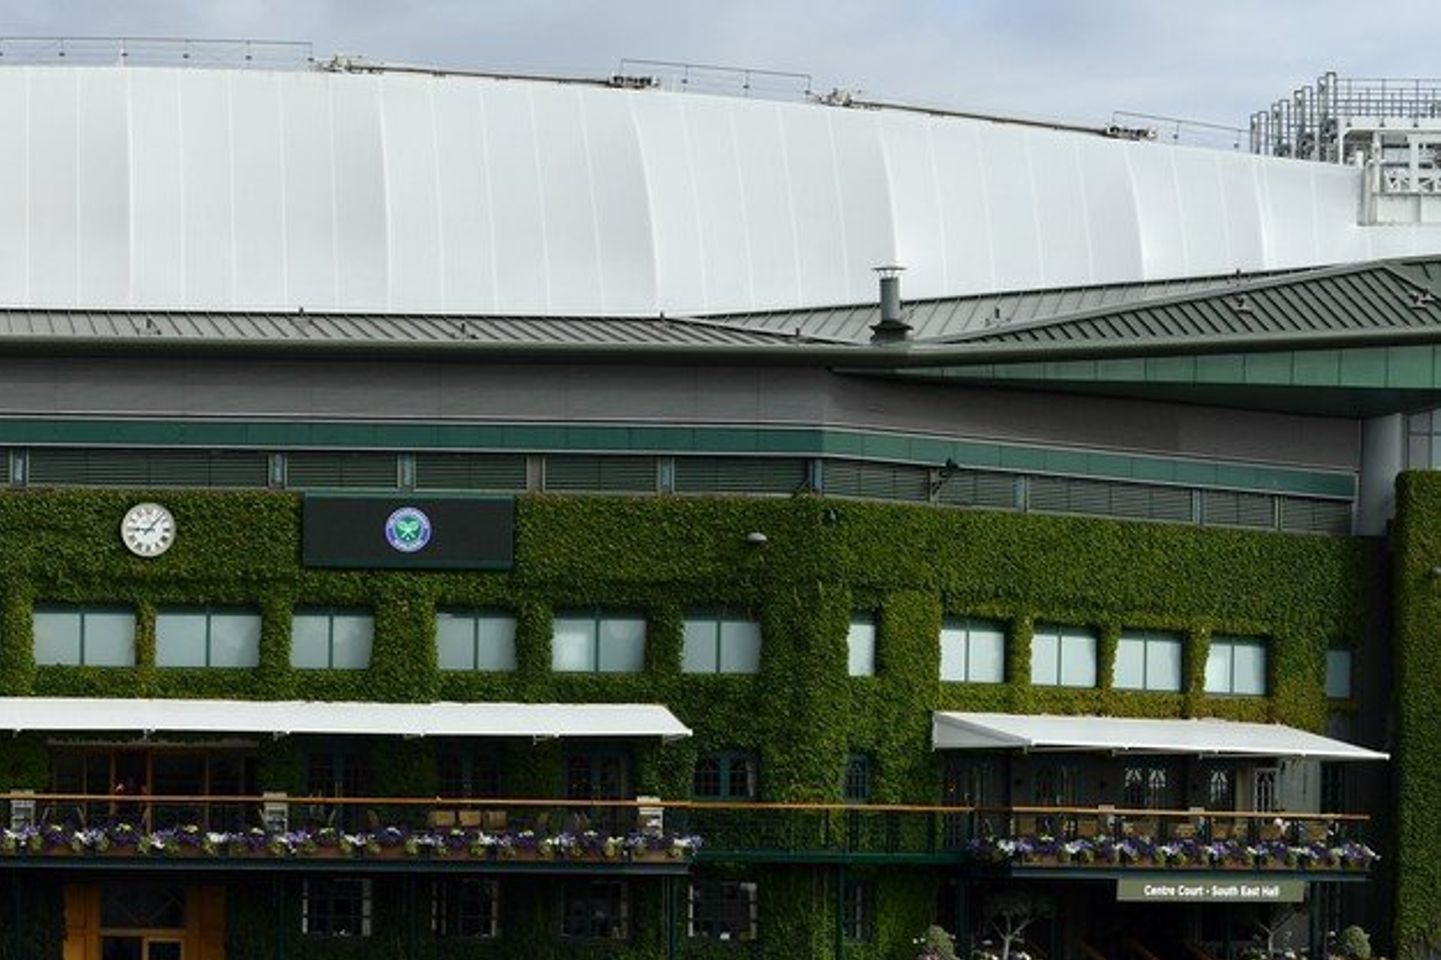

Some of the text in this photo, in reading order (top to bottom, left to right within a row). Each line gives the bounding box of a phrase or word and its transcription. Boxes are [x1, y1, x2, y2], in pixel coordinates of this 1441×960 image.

[1144, 884, 1280, 897] Centre Court South East Hall
